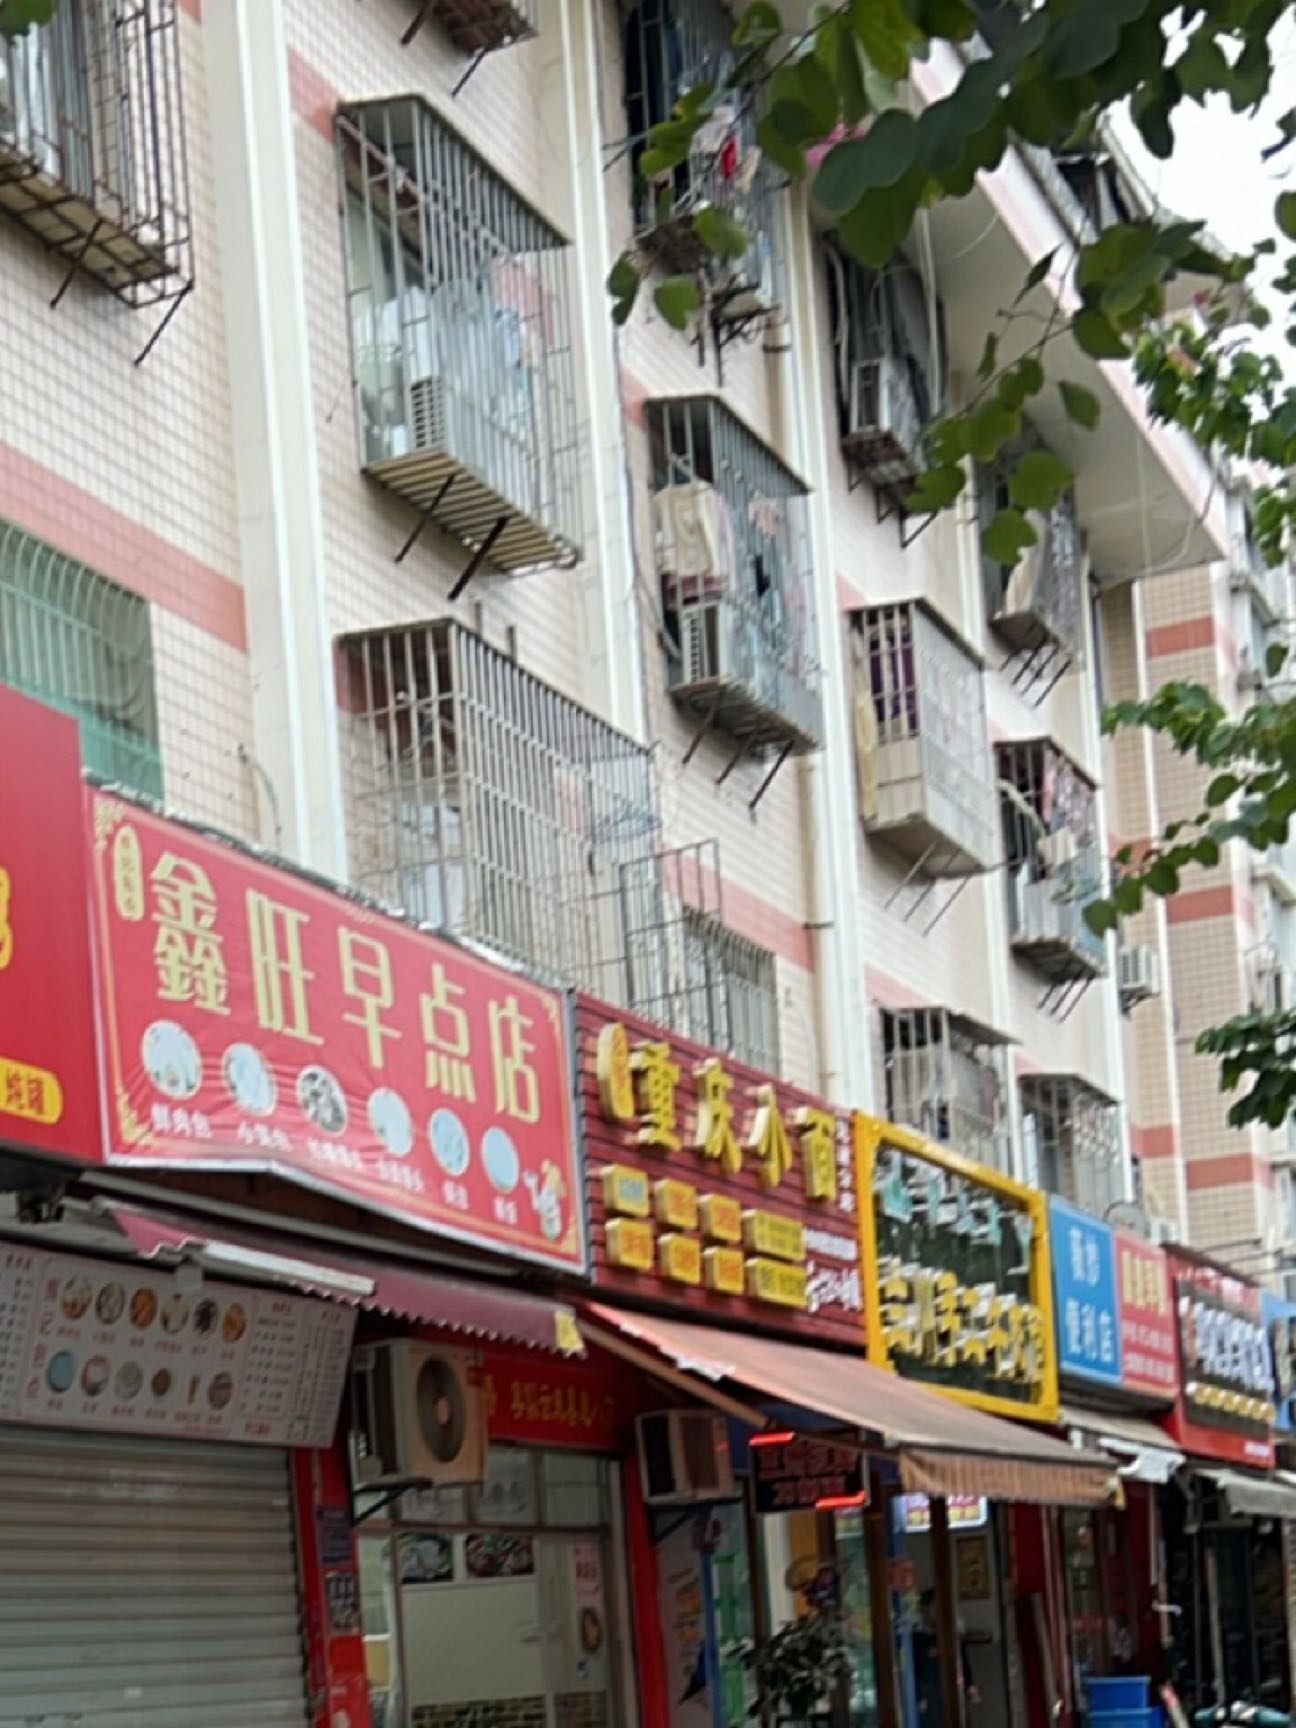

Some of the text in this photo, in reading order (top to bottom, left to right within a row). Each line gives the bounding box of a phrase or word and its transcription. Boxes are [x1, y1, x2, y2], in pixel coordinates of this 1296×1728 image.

[152, 852, 541, 1125] 鑫旺早点店
